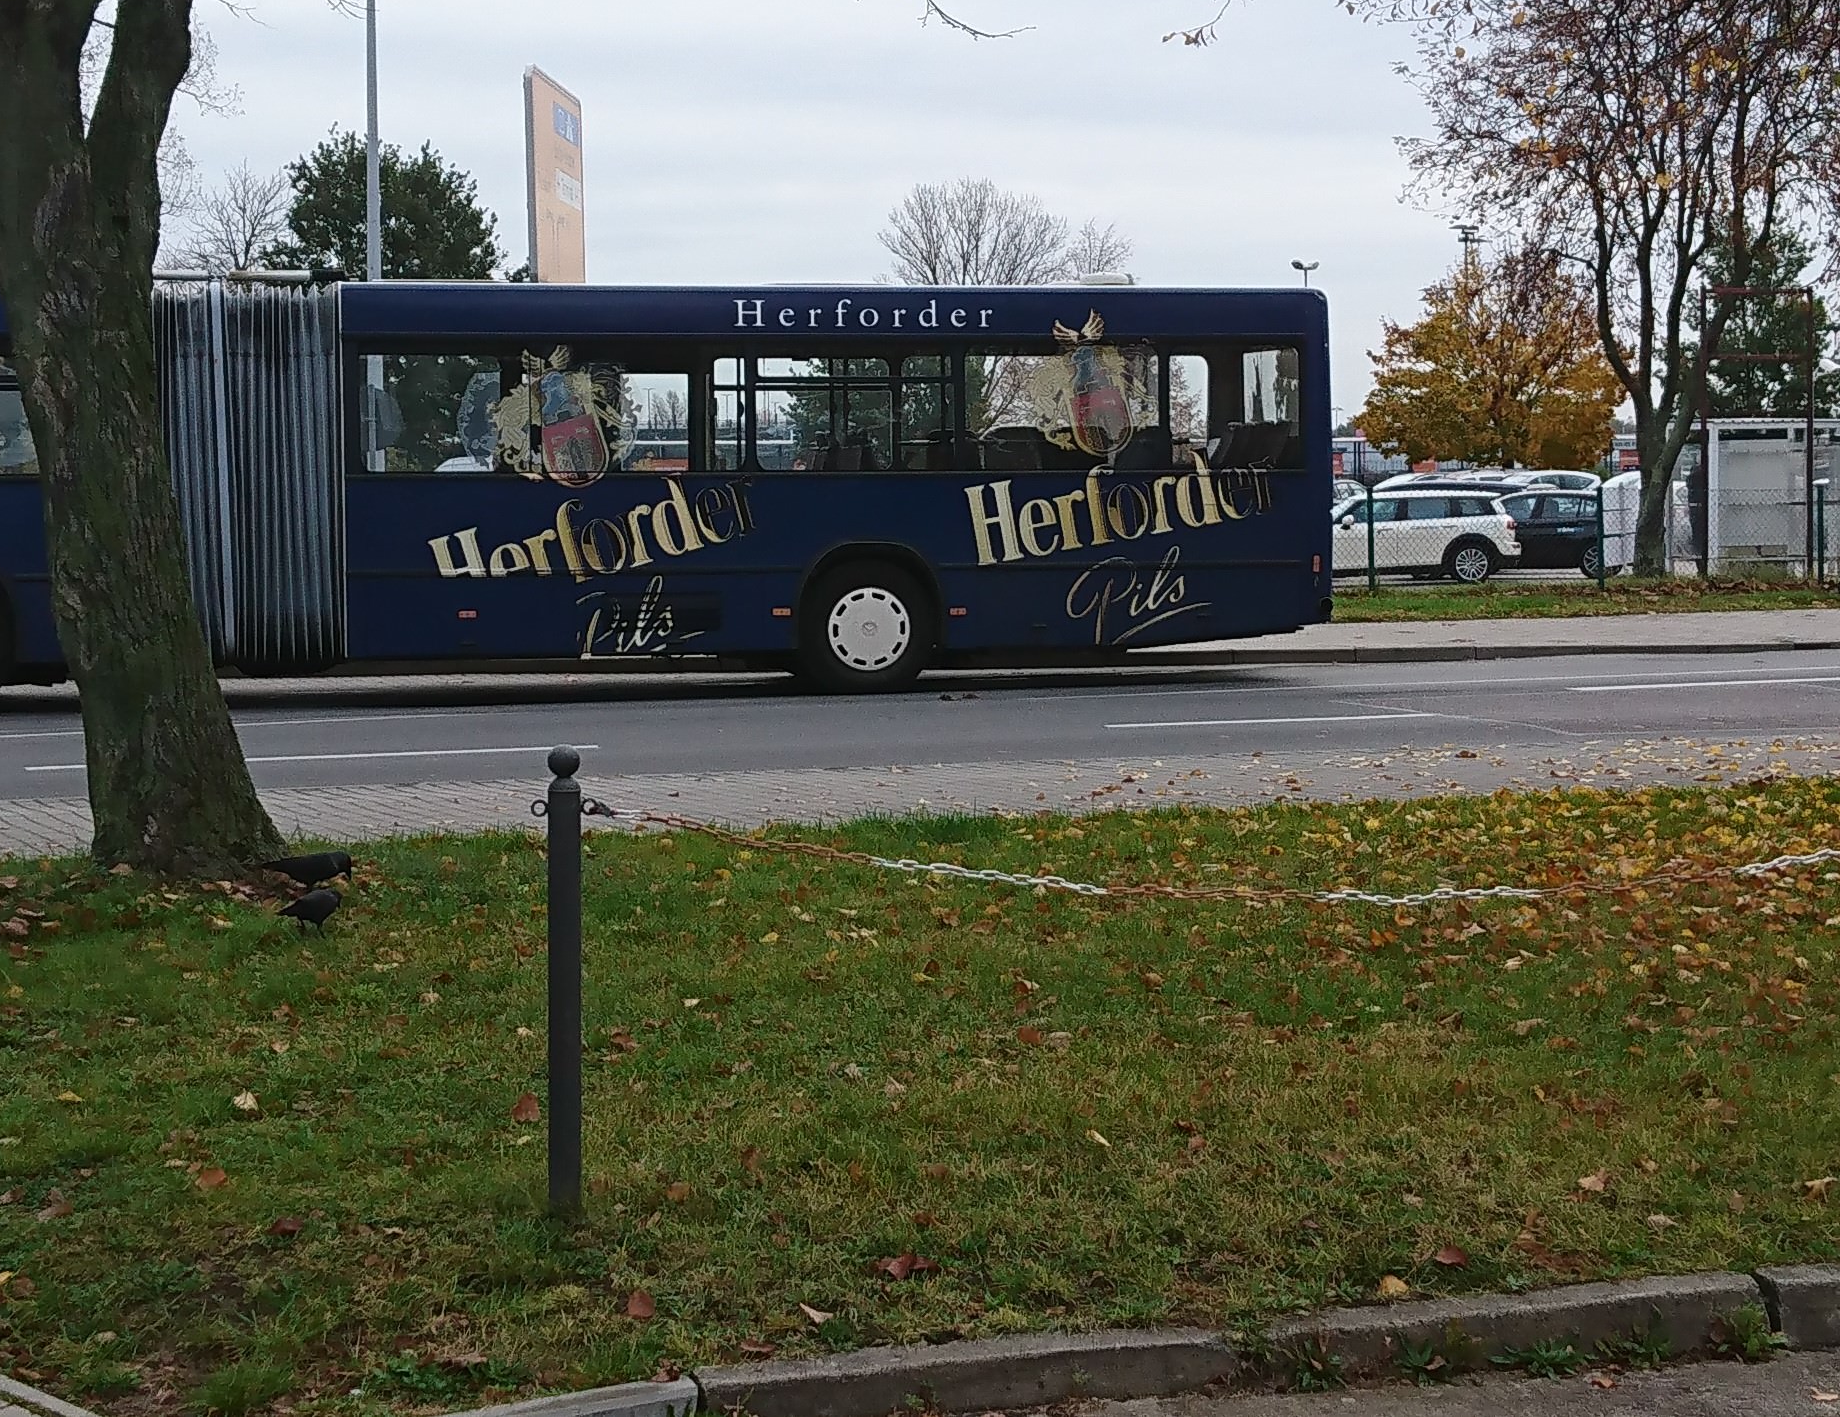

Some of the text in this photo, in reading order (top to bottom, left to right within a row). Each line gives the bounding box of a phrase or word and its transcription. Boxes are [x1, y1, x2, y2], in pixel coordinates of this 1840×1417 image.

[733, 299, 993, 328] Herforder
[963, 448, 1274, 566] Herforder
[1066, 546, 1186, 645] Pils
